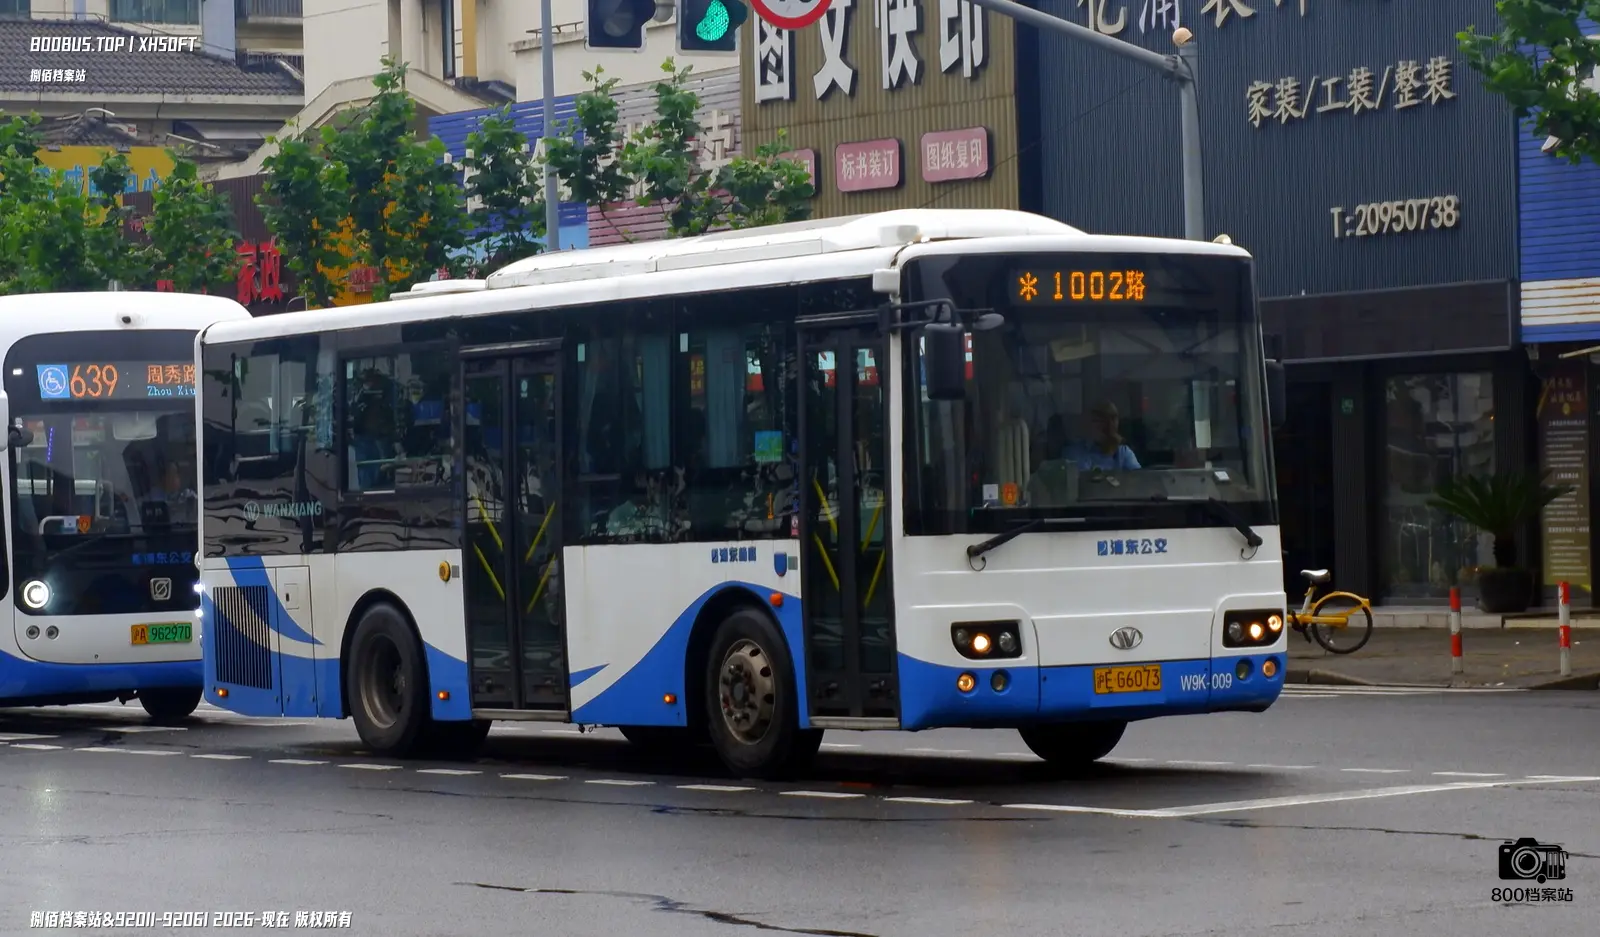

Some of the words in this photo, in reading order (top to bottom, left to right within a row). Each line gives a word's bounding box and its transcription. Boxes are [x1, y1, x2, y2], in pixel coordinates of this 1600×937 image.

[1246, 56, 1455, 127] 家装/工装/整装
[841, 149, 894, 181] 标书装订
[926, 139, 982, 171] 图纸复印
[1331, 195, 1459, 238] T:20950738
[1054, 270, 1146, 300] 1002路
[70, 364, 118, 398] 639
[147, 364, 196, 385] 周秀路
[147, 385, 172, 396] Zhou
[263, 501, 322, 518] WANXIANG
[1110, 538, 1168, 555] 浦东公交
[1181, 672, 1233, 692] W9K-009
